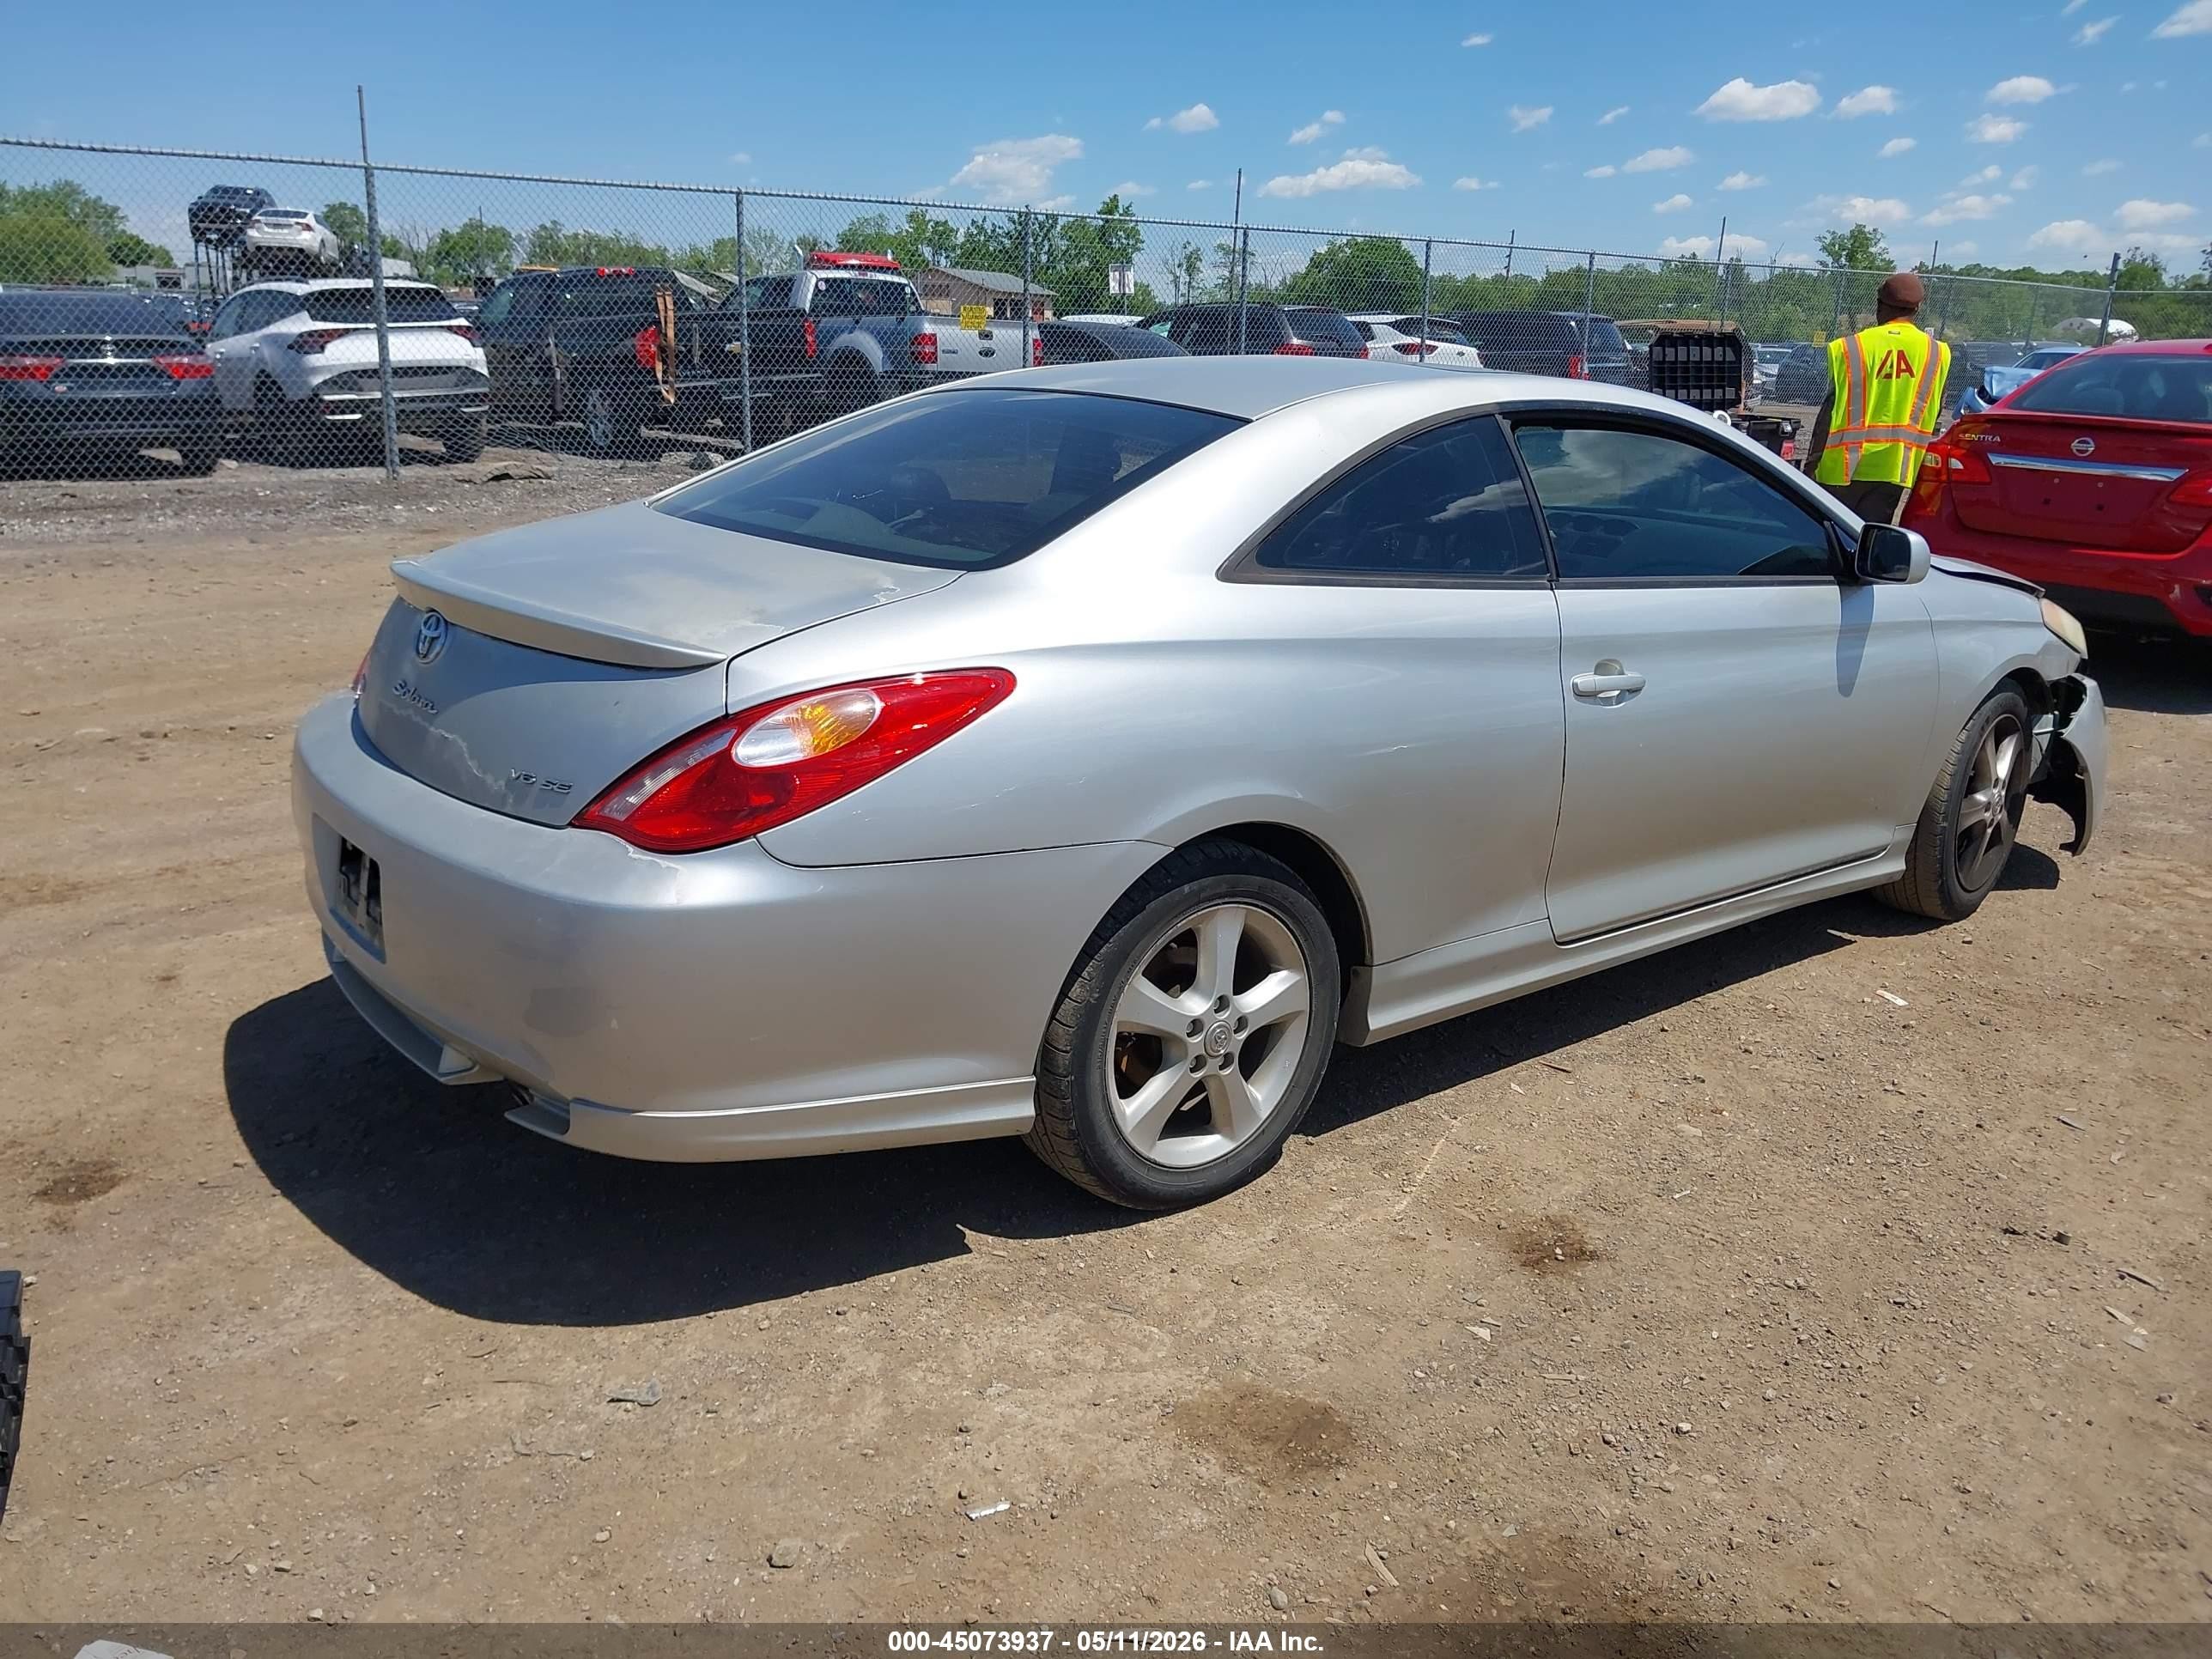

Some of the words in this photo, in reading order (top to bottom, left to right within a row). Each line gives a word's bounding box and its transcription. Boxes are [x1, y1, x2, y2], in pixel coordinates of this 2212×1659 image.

[1958, 433, 2002, 442] SENTRA
[510, 769, 537, 784] V6
[540, 779, 574, 794] SE
